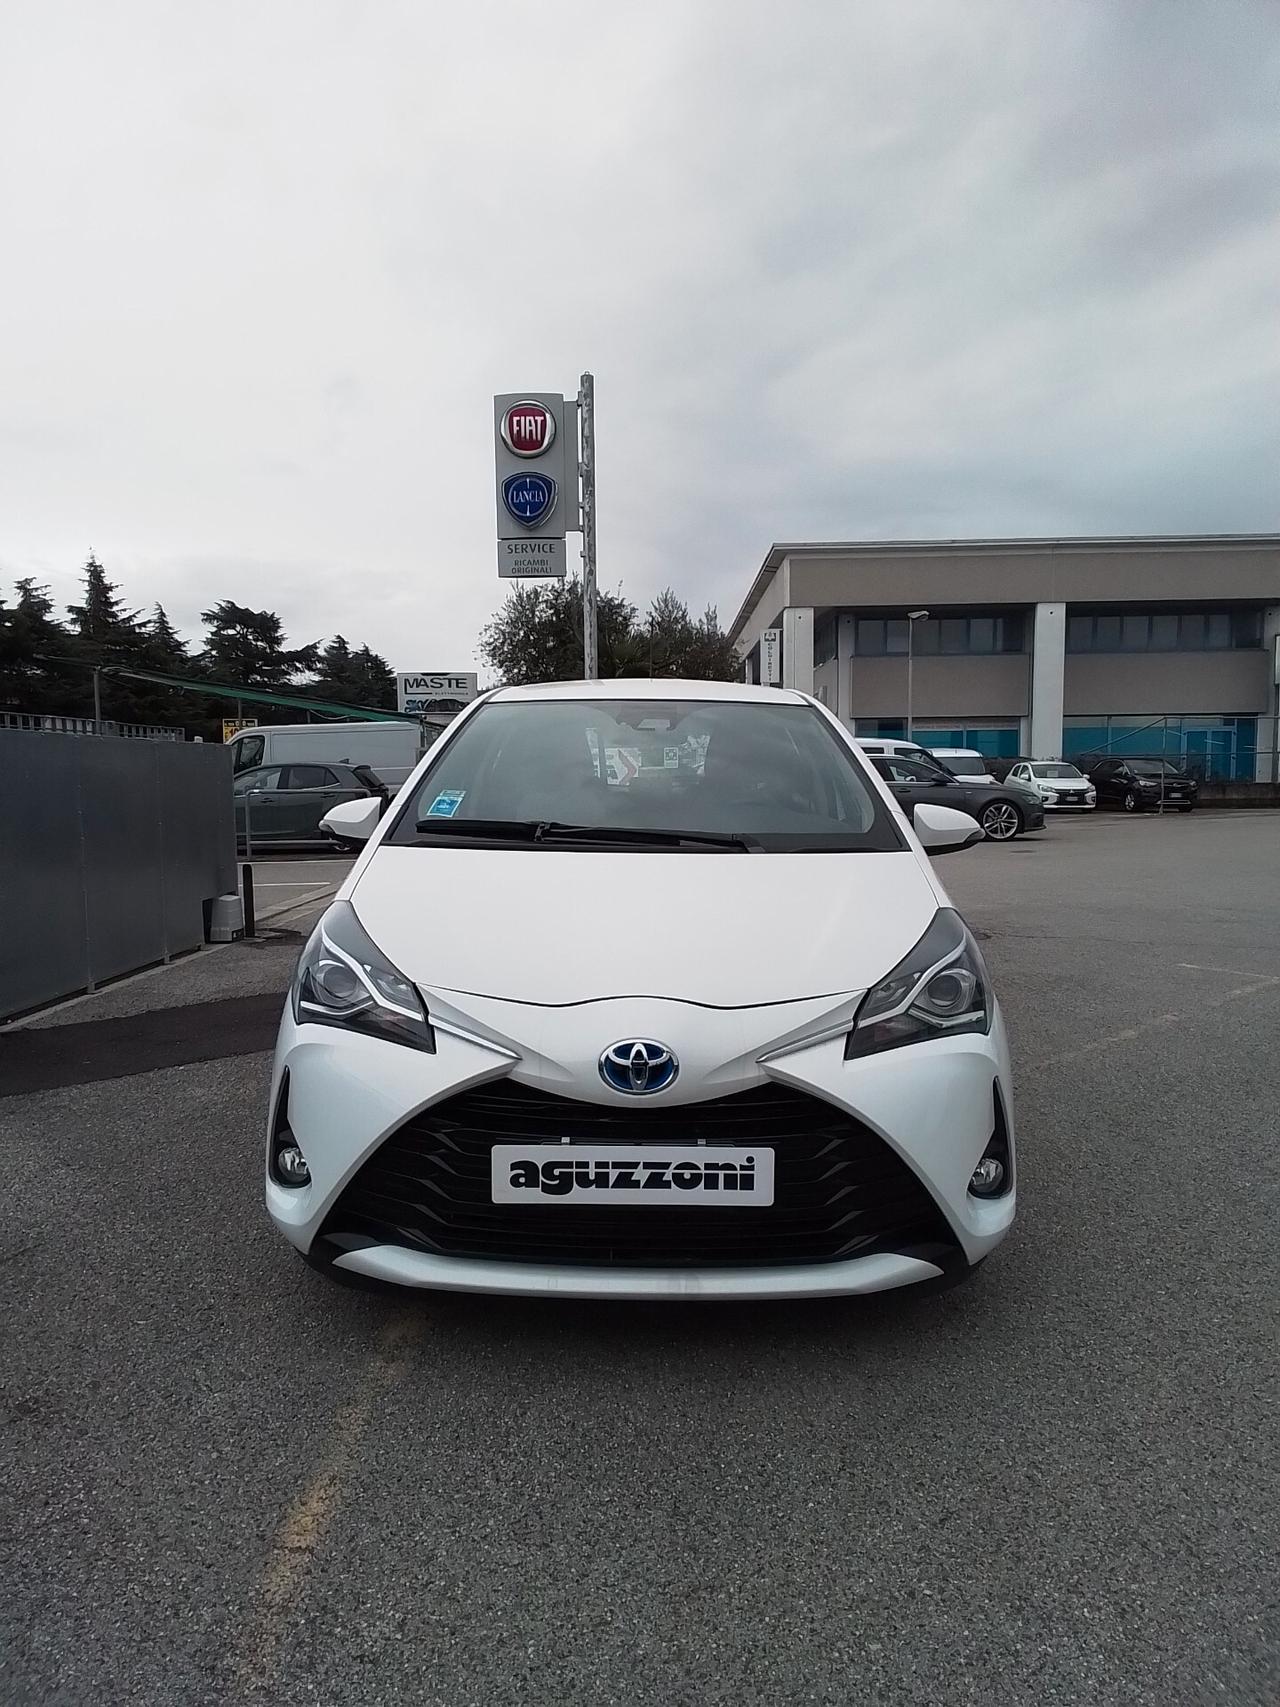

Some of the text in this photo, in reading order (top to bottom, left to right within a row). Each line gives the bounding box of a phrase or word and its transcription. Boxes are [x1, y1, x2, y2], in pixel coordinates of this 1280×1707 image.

[513, 416, 545, 441] FIAT
[513, 490, 544, 503] LANCIA
[507, 543, 555, 554] SERVICE
[514, 559, 549, 567] RICAMBI
[511, 567, 552, 575] ORIGINALI
[404, 677, 468, 690] MASTE
[509, 1156, 755, 1195] aguzzoni
